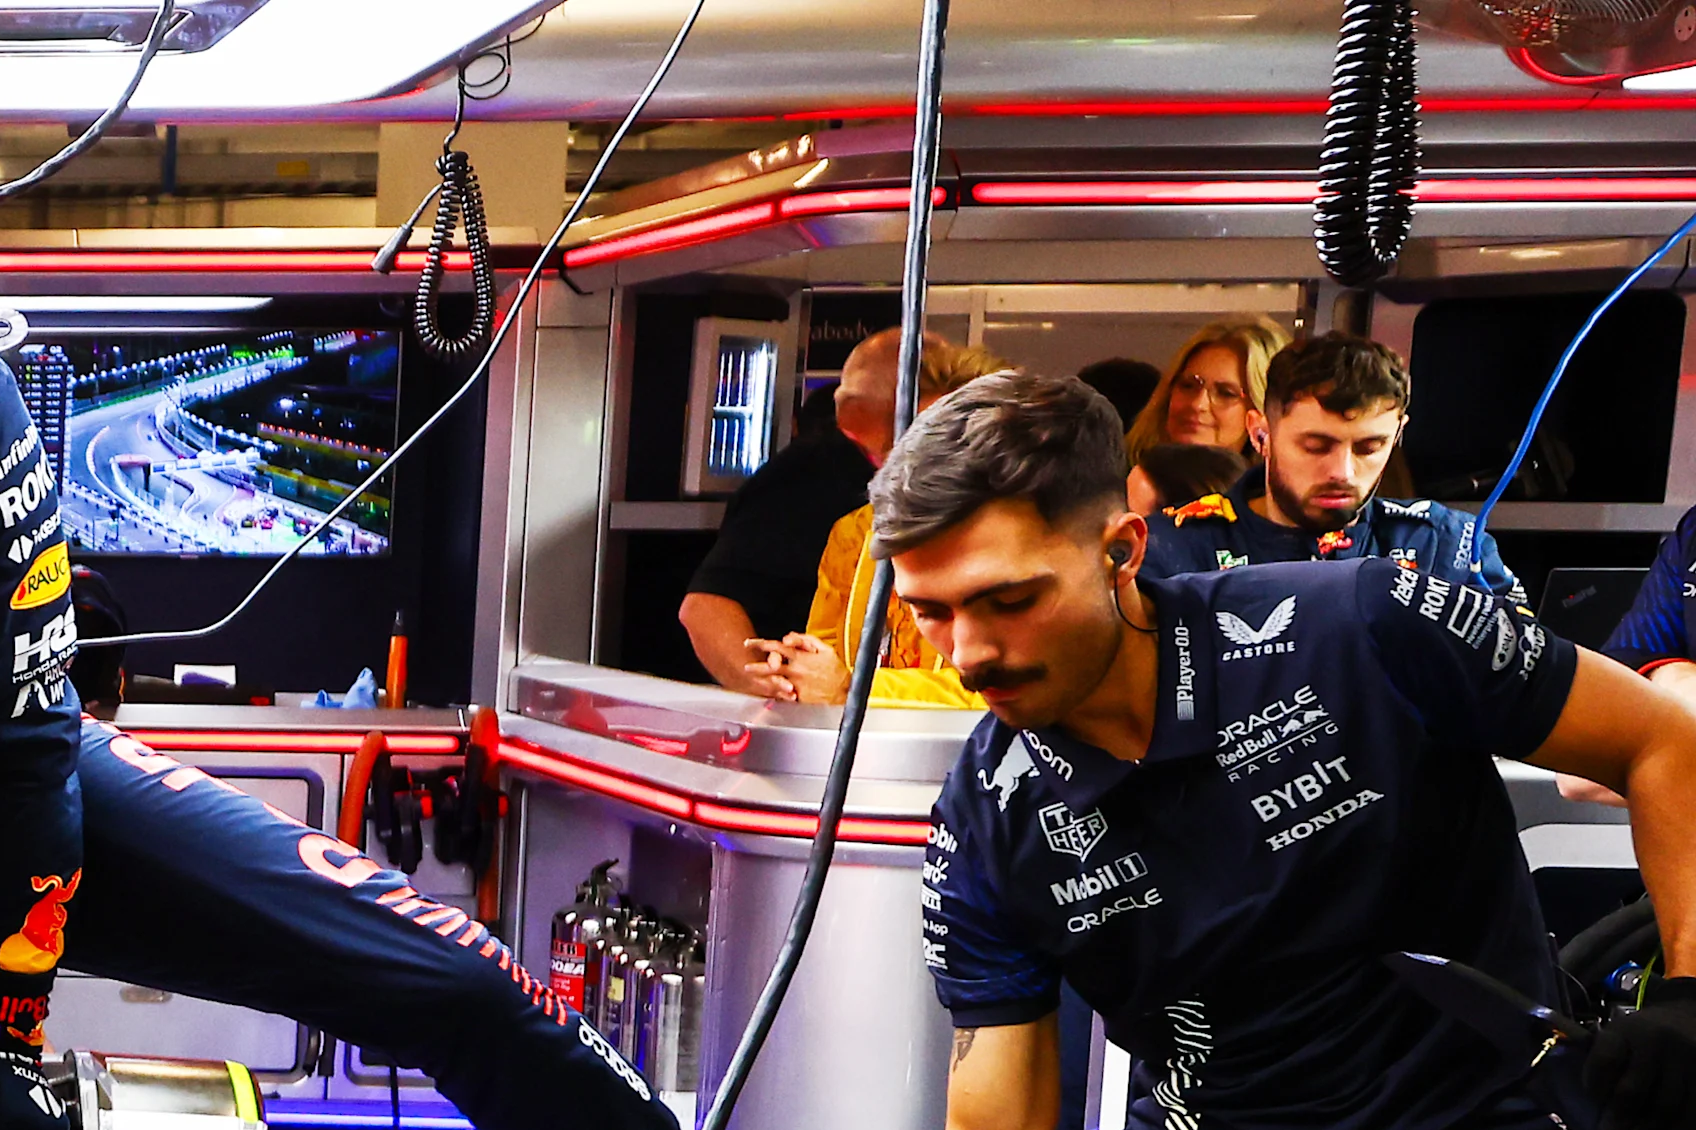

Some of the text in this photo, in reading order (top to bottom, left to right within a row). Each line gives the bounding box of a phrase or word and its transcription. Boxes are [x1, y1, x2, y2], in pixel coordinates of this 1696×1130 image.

[26, 554, 68, 596] RAUC
[1419, 575, 1452, 622] ROKT
[12, 656, 59, 684] Honda
[1222, 641, 1296, 662] CASTORE
[1217, 685, 1318, 748] ORACLE
[1215, 728, 1279, 767] Red Bull
[1227, 722, 1340, 784] RACING
[1250, 756, 1352, 823] BYBIT
[1265, 789, 1385, 852] HONDA
[1050, 864, 1119, 906] Mobil
[1067, 887, 1164, 933] ORACLE
